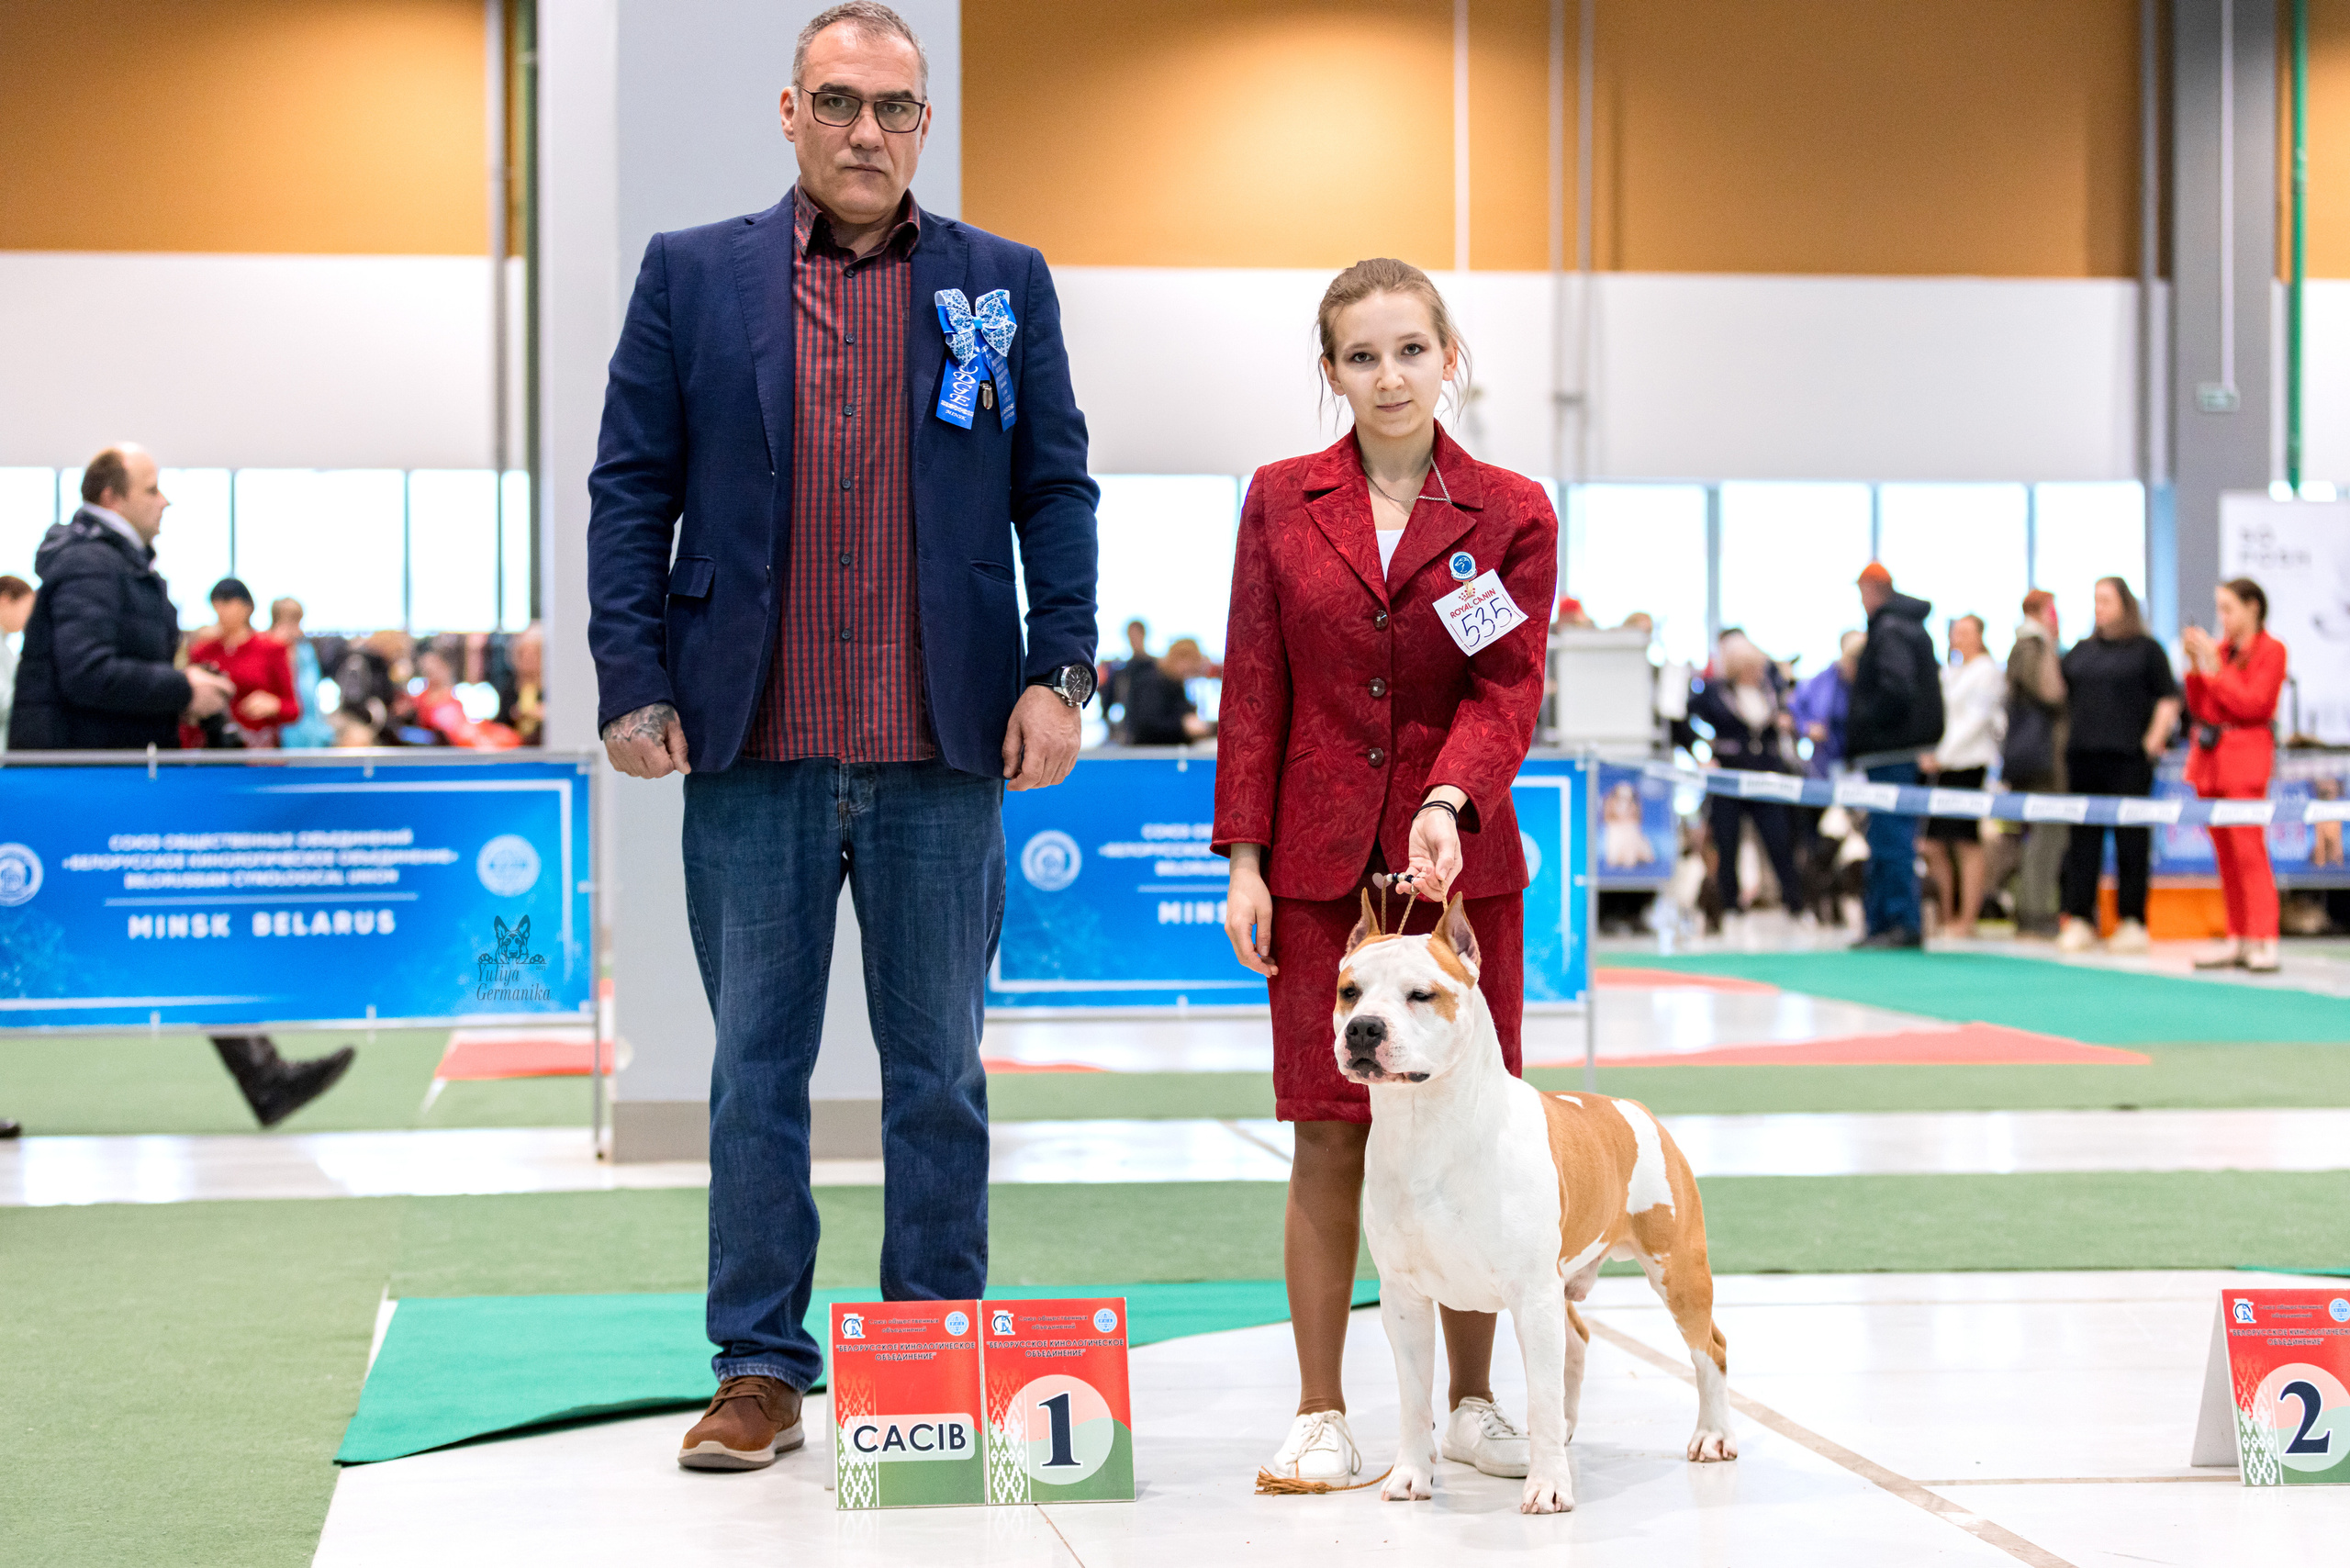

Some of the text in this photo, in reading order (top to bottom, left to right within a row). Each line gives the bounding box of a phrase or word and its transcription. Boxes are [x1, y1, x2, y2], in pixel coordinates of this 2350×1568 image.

[1449, 588, 1496, 619] ROYAL CANIN
[1461, 598, 1513, 647] 535
[128, 909, 396, 940] MINSK BELARUS
[835, 1341, 976, 1352] "БЕЛОРУССКОЕ КИНОЛОГИЧЕСКОЕ
[986, 1338, 1124, 1350] "БЕЛОРУССКОЕ КИНОЛОГИЧЕСКОЕ
[2289, 1328, 2350, 1337] КИНОЛОГИЧЕСК
[875, 1351, 937, 1361] ОБЪЕДИНЕНИЕ"
[1024, 1349, 1086, 1359] ОБЪЕДИНЕНИЕ"
[1037, 1391, 1081, 1468] 1
[2279, 1380, 2331, 1454] 2
[853, 1422, 967, 1453] CACIB
